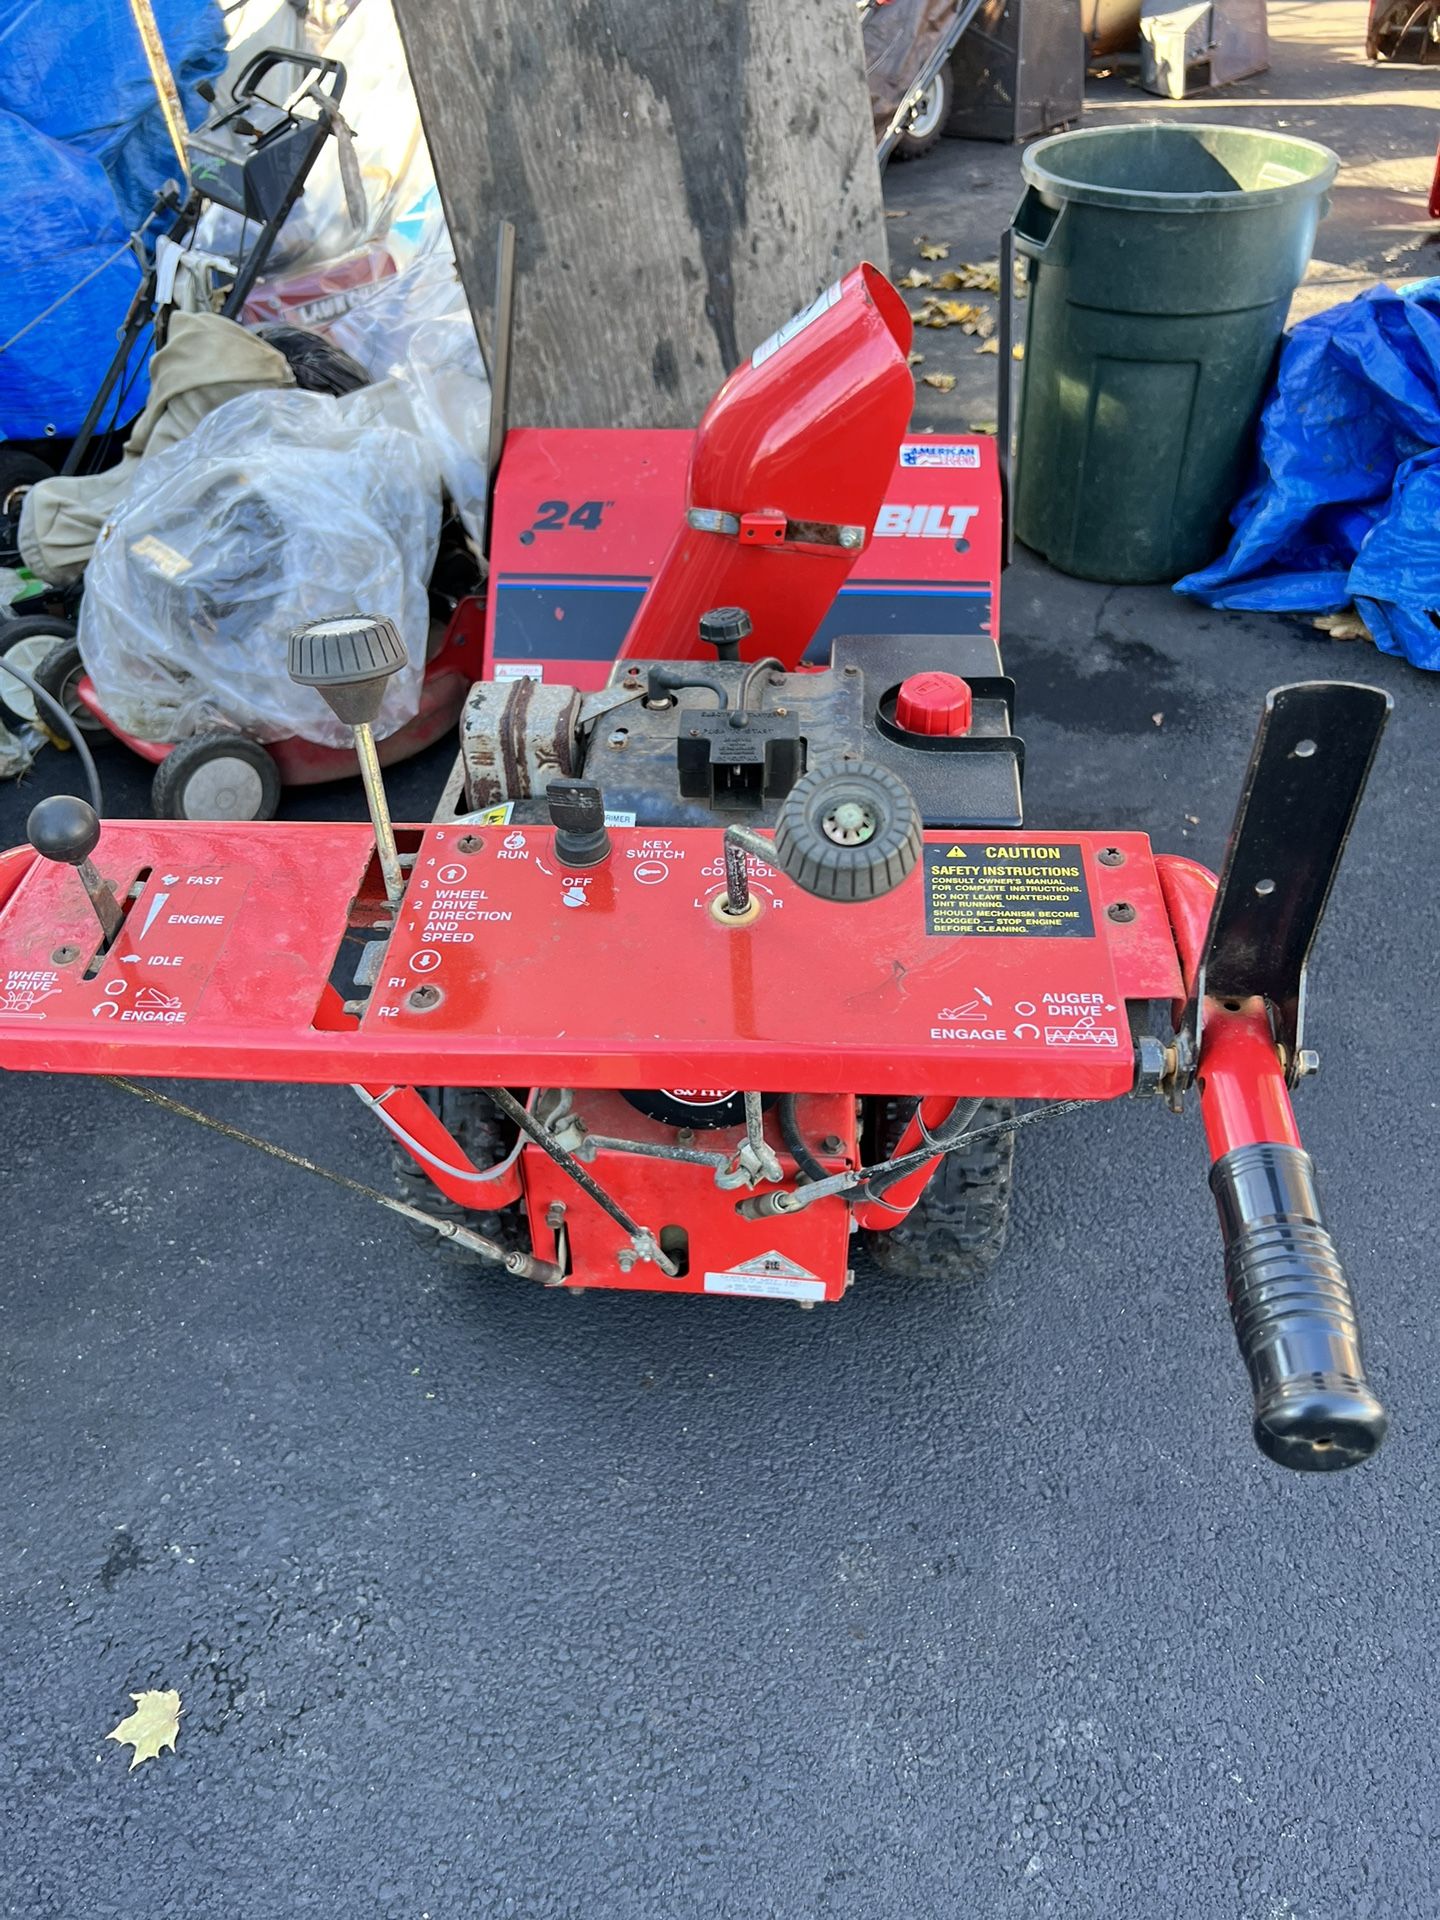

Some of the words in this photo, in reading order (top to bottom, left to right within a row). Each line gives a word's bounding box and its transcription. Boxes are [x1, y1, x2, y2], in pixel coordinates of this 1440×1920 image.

[911, 447, 974, 455] AMERICAN
[872, 505, 979, 538] BILT
[605, 814, 631, 823] RIMER
[436, 831, 445, 840] 5
[643, 840, 672, 849] KEY
[497, 850, 530, 860] RUN
[626, 849, 685, 859] SWITCH
[985, 847, 1061, 859] CAUTION
[427, 858, 436, 866] 4
[714, 857, 766, 867] CTE
[701, 867, 776, 877] COROL
[931, 866, 980, 876] SAFETY
[983, 866, 1080, 877] INSTRUCTIONS
[186, 876, 223, 885] FAST
[420, 880, 429, 888] 3
[562, 877, 593, 887] OFF
[435, 890, 488, 899] WHEEL
[413, 901, 423, 910] 2
[431, 901, 478, 910] DRIVE
[693, 898, 702, 908] L
[773, 899, 784, 908] R
[168, 915, 225, 925] ENGINE
[428, 911, 512, 921] DIRECTION
[408, 922, 415, 931] 1
[424, 922, 458, 931] AND
[421, 932, 474, 942] SPEED
[148, 956, 184, 966] IDLE
[8, 971, 59, 981] WHEEL
[4, 980, 53, 991] DRIVE
[388, 977, 407, 987] R1
[1042, 993, 1104, 1004] AUGER
[378, 1006, 400, 1017] R2
[1048, 1005, 1102, 1016] DRIVE
[120, 1011, 187, 1022] ENGAGE
[930, 1028, 1008, 1040] ENGAGE
